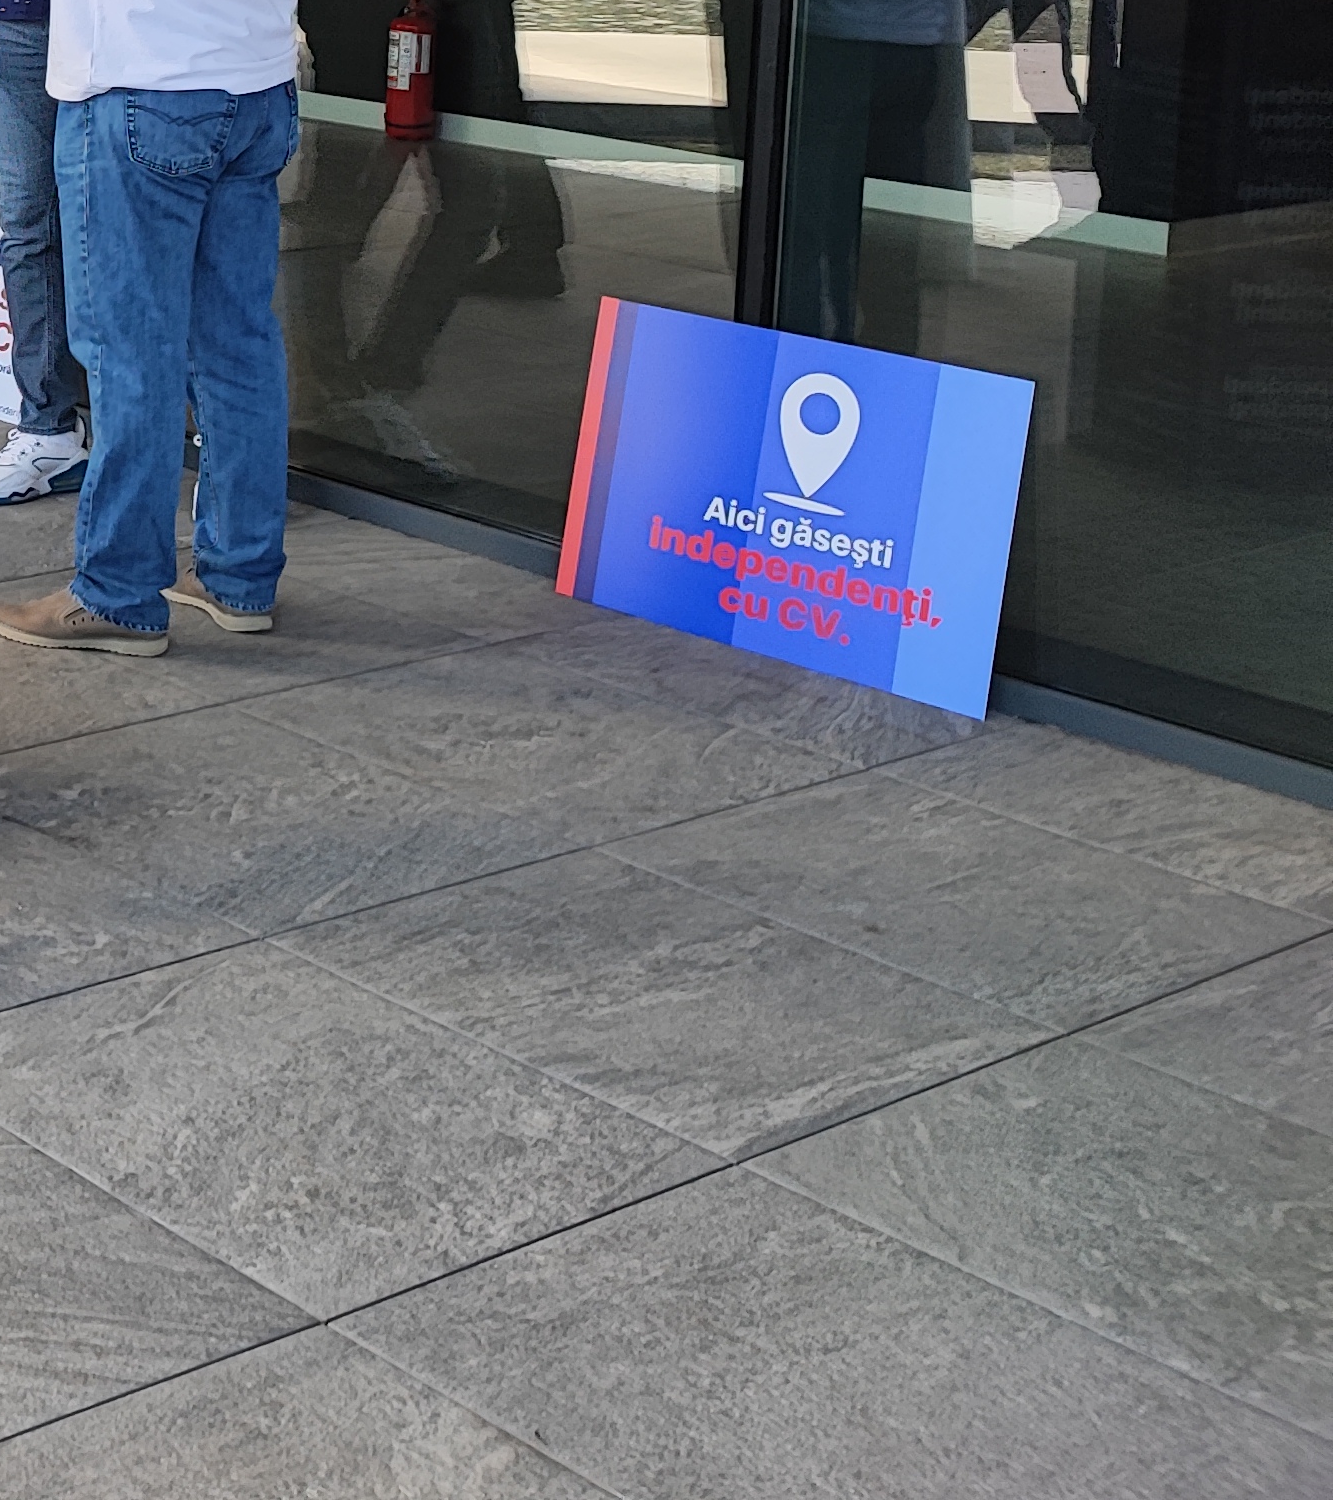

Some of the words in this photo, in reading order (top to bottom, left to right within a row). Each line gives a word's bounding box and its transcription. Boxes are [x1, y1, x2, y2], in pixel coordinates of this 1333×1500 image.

[703, 496, 767, 535] Aici
[718, 586, 769, 622] cu
[778, 598, 851, 646] CV.
